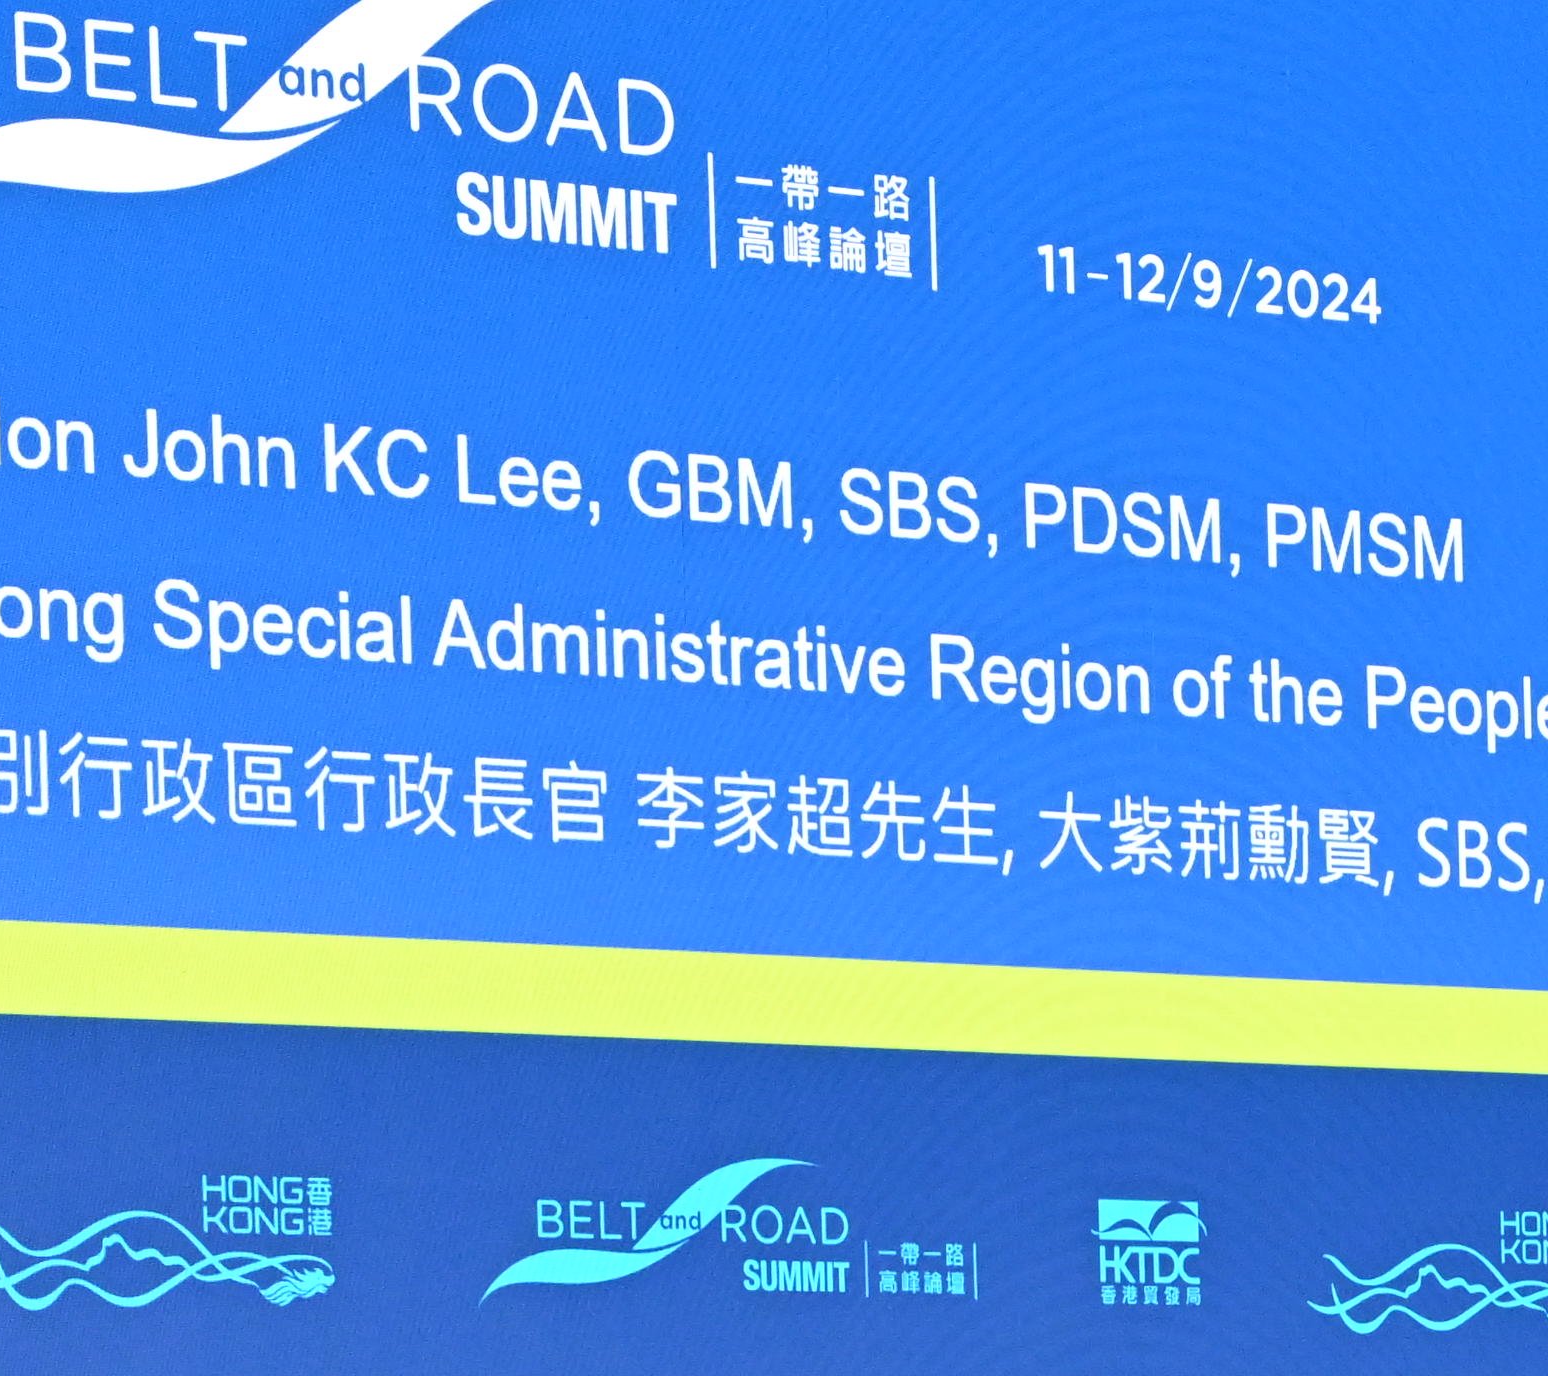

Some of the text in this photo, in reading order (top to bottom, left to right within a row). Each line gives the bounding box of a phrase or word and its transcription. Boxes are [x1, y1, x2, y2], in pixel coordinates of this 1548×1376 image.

[14, 11, 675, 156] BELT and ROAD
[457, 172, 677, 253] SUMMIT
[736, 165, 909, 221] 一帶一路
[737, 217, 912, 277] 高峰論壇
[1038, 245, 1381, 323] 11-12/9/2024
[124, 409, 295, 489] John
[324, 423, 429, 498] KC
[457, 434, 599, 526] Lee,
[629, 450, 812, 543] GBM,
[840, 468, 997, 557] SBS,
[1025, 483, 1240, 577] PDSM,
[1267, 503, 1463, 582] PMSM
[154, 579, 412, 669] Special
[433, 599, 905, 696] Administrative
[931, 634, 1149, 724] Region
[1173, 655, 1232, 719] of
[1249, 659, 1342, 726] the
[637, 767, 1013, 875] 李家超先生,
[1039, 792, 1394, 896] 大紫荊勳賢,
[1418, 818, 1544, 903] SBS,
